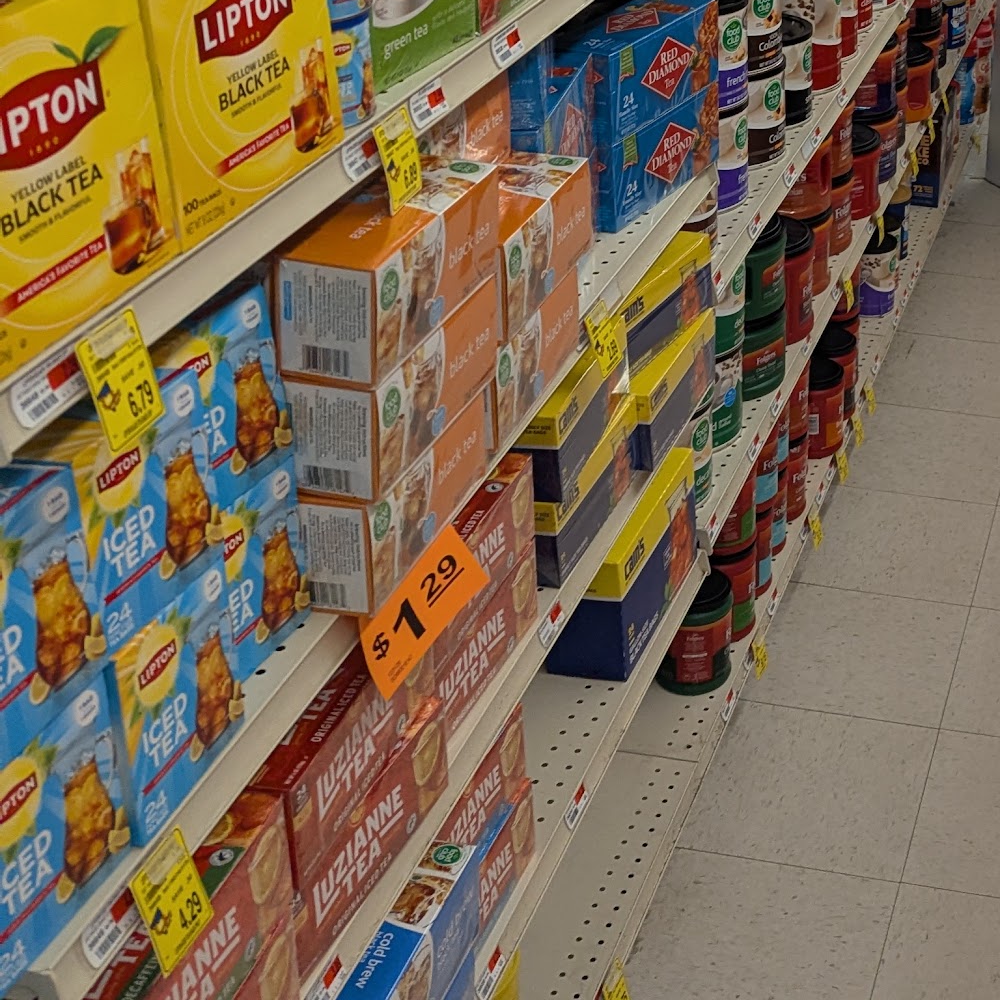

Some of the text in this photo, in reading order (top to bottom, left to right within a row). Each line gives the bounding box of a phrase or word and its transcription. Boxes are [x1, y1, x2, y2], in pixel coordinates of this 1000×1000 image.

[757, 3, 771, 14] club
[384, 25, 429, 58] green tea
[726, 25, 740, 38] food
[727, 35, 740, 47] club
[226, 48, 279, 84] YELLOW LABEL
[649, 51, 691, 86] DIAMOND
[660, 46, 678, 66] RED
[218, 56, 290, 112] BLACK TEA
[623, 91, 634, 109] 24
[664, 77, 676, 90] Tea
[652, 135, 693, 172] DIAMOND
[664, 132, 681, 151] RED
[10, 156, 87, 202] YELLOW LABEL
[0, 164, 104, 238] BLACK TEA
[183, 198, 199, 216] 100
[556, 207, 586, 246] black tea
[89, 241, 104, 254] TEA
[450, 223, 491, 269] black tea
[450, 328, 491, 378] black tea
[127, 380, 154, 418] 6.79
[99, 452, 140, 490] LIPTON
[103, 505, 156, 561] ICED
[110, 537, 156, 577] TEA
[625, 536, 645, 580] Cain's
[106, 603, 133, 633] 24
[140, 641, 176, 686] LIPTON
[439, 608, 506, 714] LUZIANNE
[460, 651, 490, 697] TEA
[142, 692, 187, 753] ICED
[302, 688, 336, 721] TEA
[149, 721, 189, 767] TEA
[310, 707, 345, 743] ORIGINAL
[341, 734, 376, 792] TEA
[312, 784, 404, 928] LUZIANNE
[342, 837, 382, 897] TEA
[5, 859, 52, 915] TEA
[178, 891, 202, 929] 4.29
[355, 932, 394, 989] cold brew
